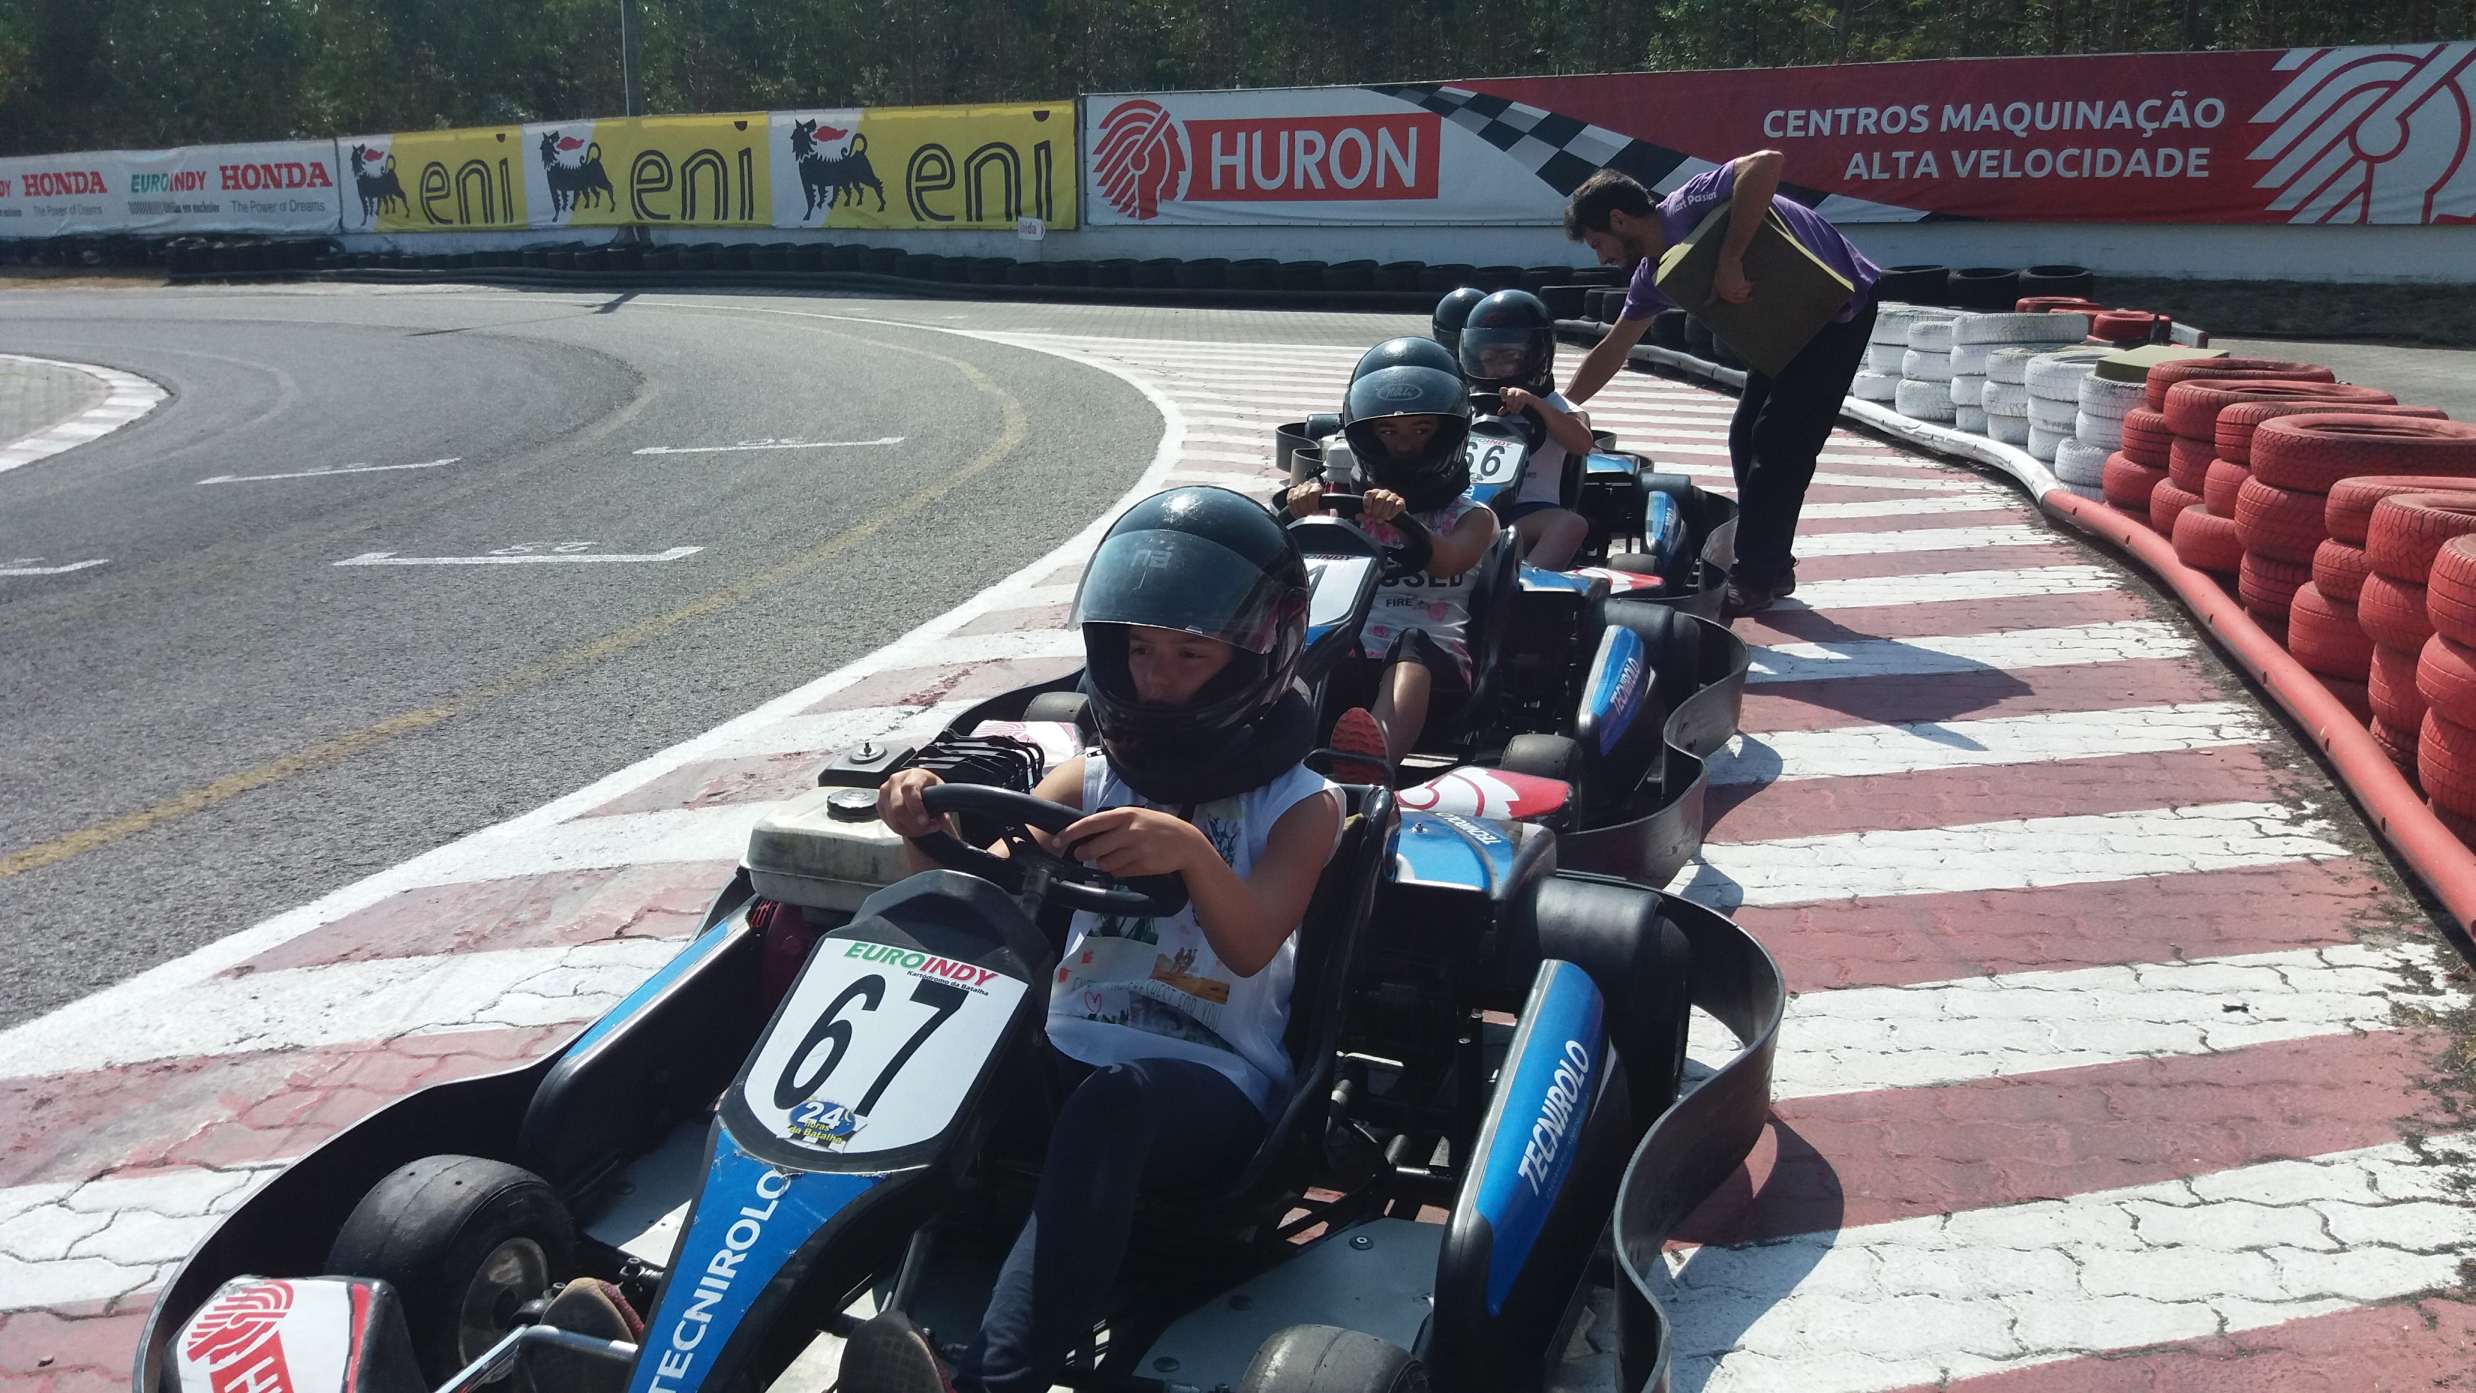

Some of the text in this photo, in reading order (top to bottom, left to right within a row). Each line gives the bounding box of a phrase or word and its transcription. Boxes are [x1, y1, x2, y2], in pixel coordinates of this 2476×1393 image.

[1762, 90, 2226, 139] CENTROS MAQUINAÇÃO
[219, 162, 333, 191] HONDA
[630, 120, 754, 222] eni
[906, 109, 1053, 222] eni
[1210, 126, 1419, 190] HURON
[1843, 147, 2211, 180] ALTA VELOCIDADE
[22, 171, 107, 196] HONDA
[131, 170, 208, 193] EUROINDY
[420, 133, 514, 225] eni
[232, 201, 248, 213] The
[250, 201, 278, 213] Power
[289, 200, 326, 213] Dreams
[844, 942, 998, 987] EUROINDY
[961, 983, 989, 996] Batalha
[773, 973, 970, 1117] 67
[797, 1101, 845, 1129] 24
[1518, 1040, 1589, 1196] TECNIROLO
[803, 1128, 843, 1145] Batalha
[648, 1168, 791, 1393] TECNIROLO
[224, 1356, 283, 1393] H
